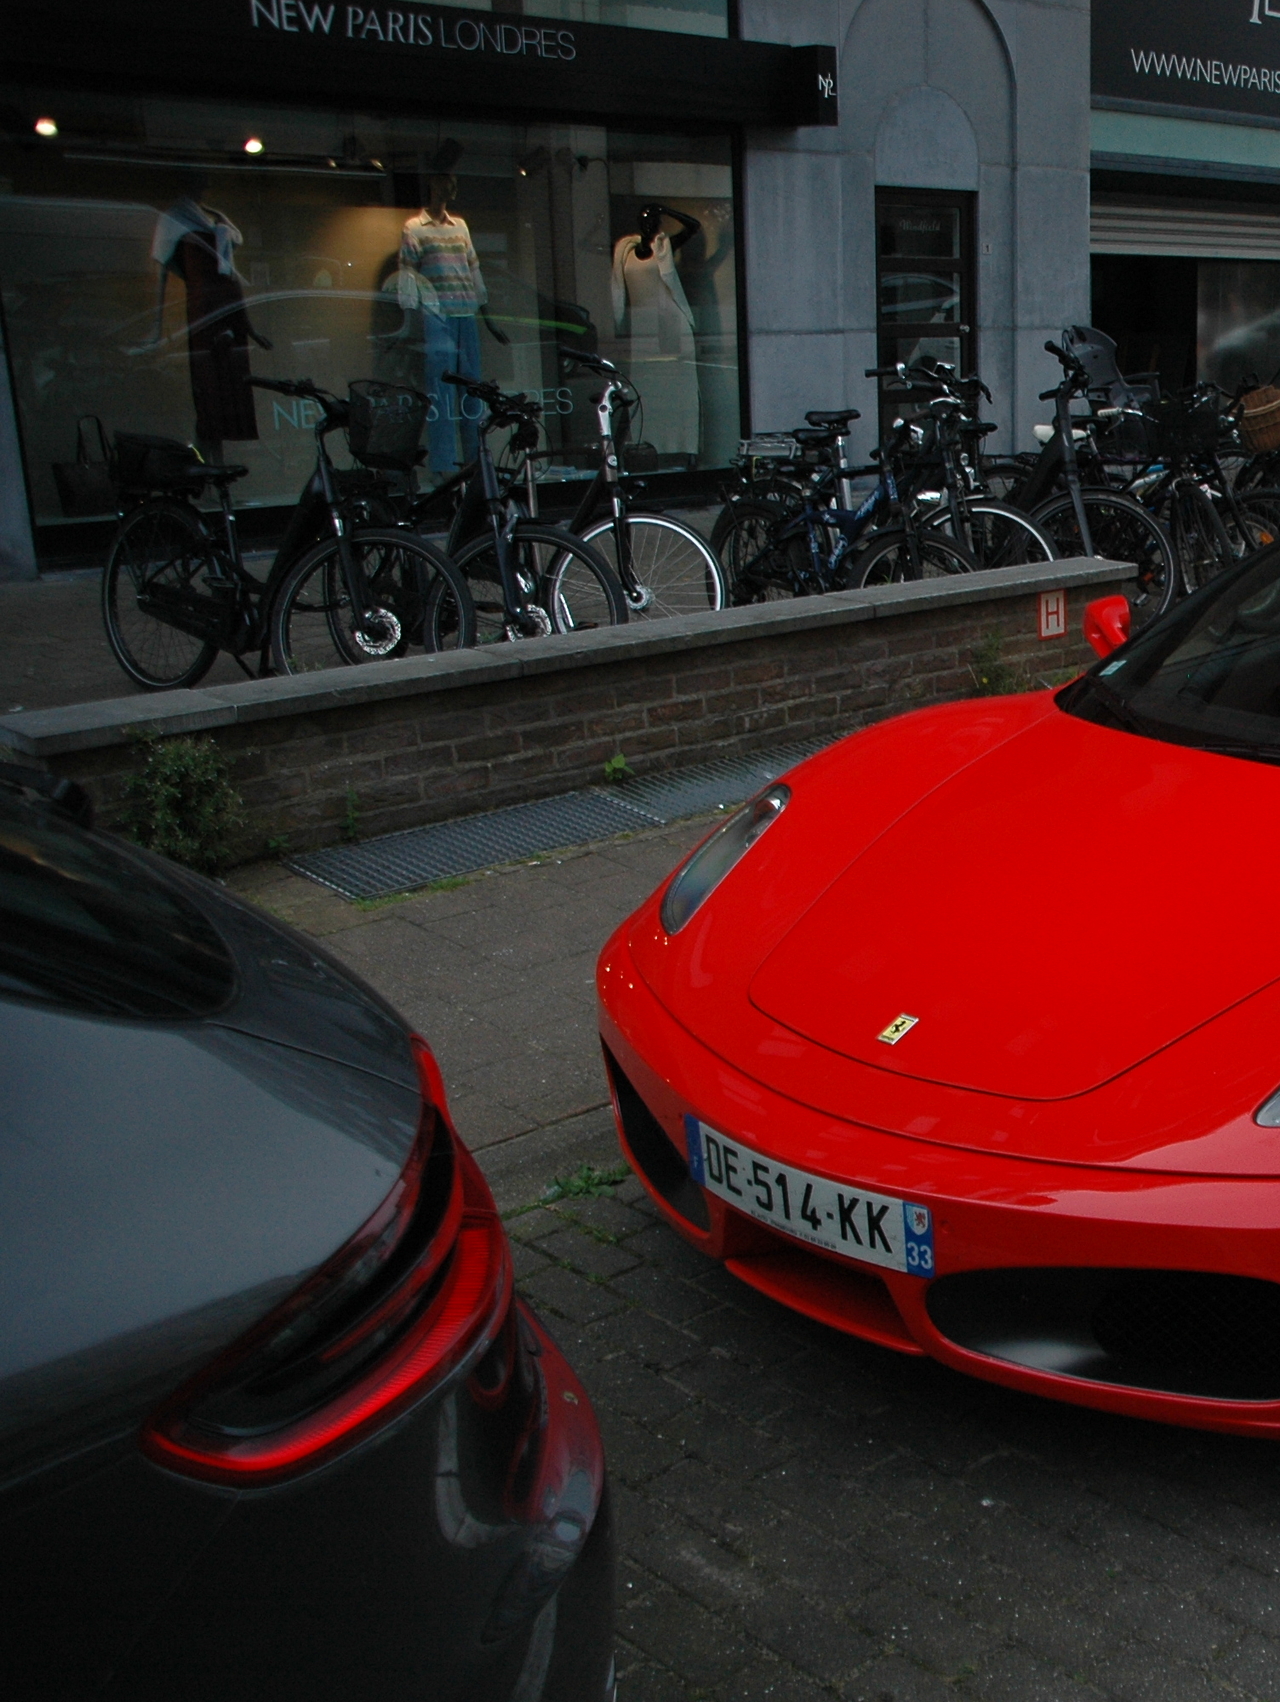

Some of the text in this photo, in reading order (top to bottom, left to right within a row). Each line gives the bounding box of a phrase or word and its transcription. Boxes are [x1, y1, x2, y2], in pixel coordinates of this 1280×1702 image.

[250, 0, 577, 61] NEW PARIS LONDRES
[445, 387, 574, 421] LOES
[1045, 597, 1060, 629] H
[705, 1134, 893, 1254] DE-514-KK
[907, 1241, 933, 1271] 33
